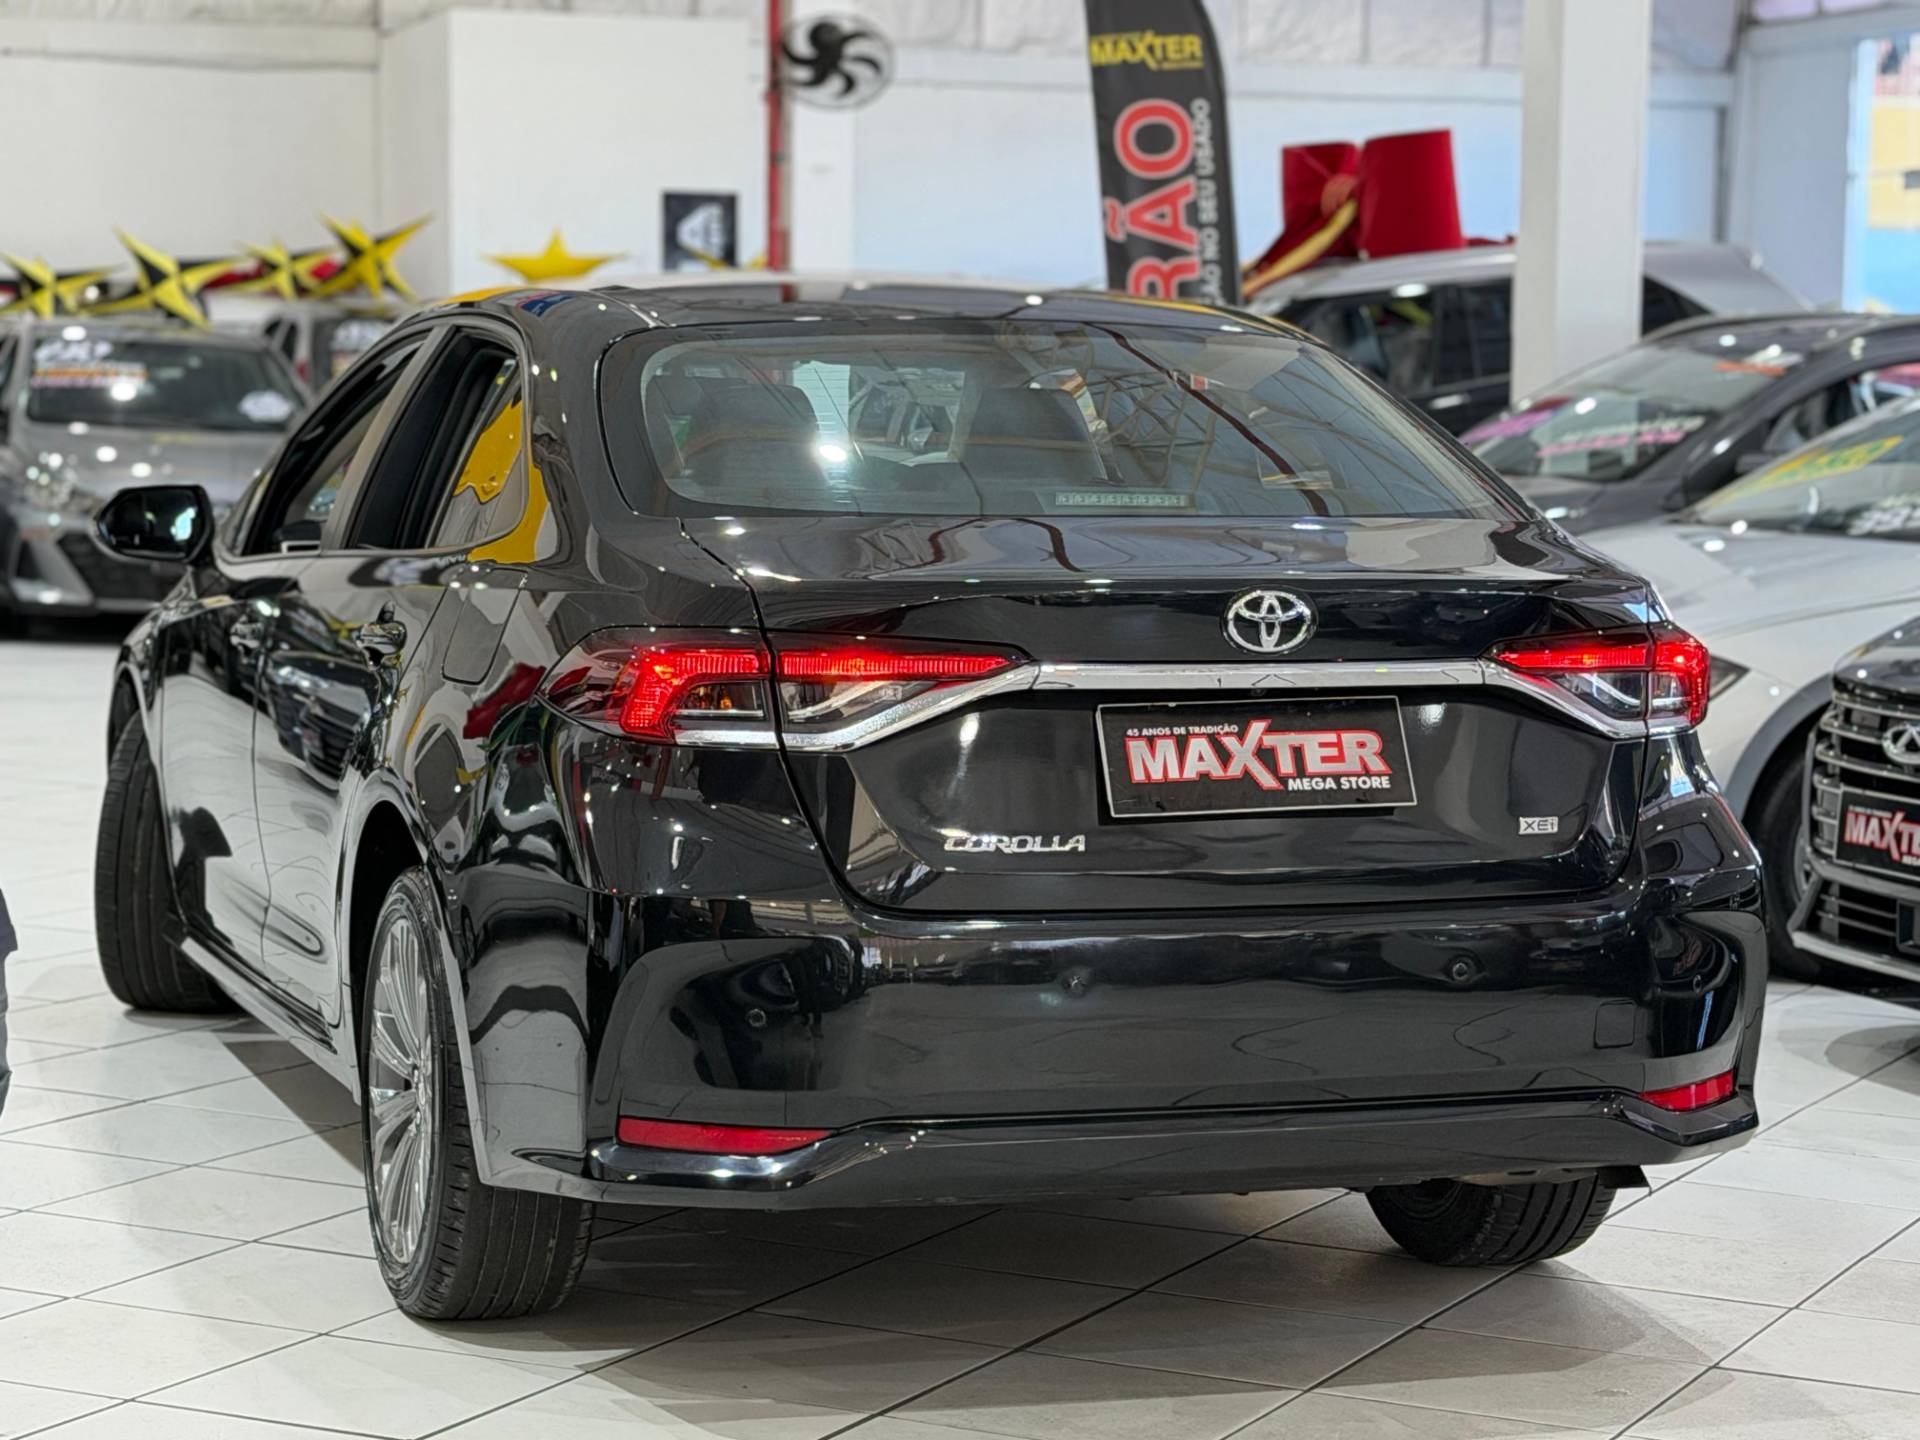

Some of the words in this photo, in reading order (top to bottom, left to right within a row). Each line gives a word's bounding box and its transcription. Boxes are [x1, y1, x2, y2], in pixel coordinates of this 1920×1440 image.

[1089, 30, 1203, 71] MAXTER
[1126, 728, 1139, 737] 45
[1142, 727, 1171, 736] ANOS
[1173, 726, 1186, 735] DE
[1188, 723, 1239, 735] TRADIÇÃO
[1125, 719, 1393, 790] MAXTER
[1288, 777, 1338, 791] MEGA
[1341, 776, 1391, 790] STORE
[944, 834, 1086, 854] COROLLA
